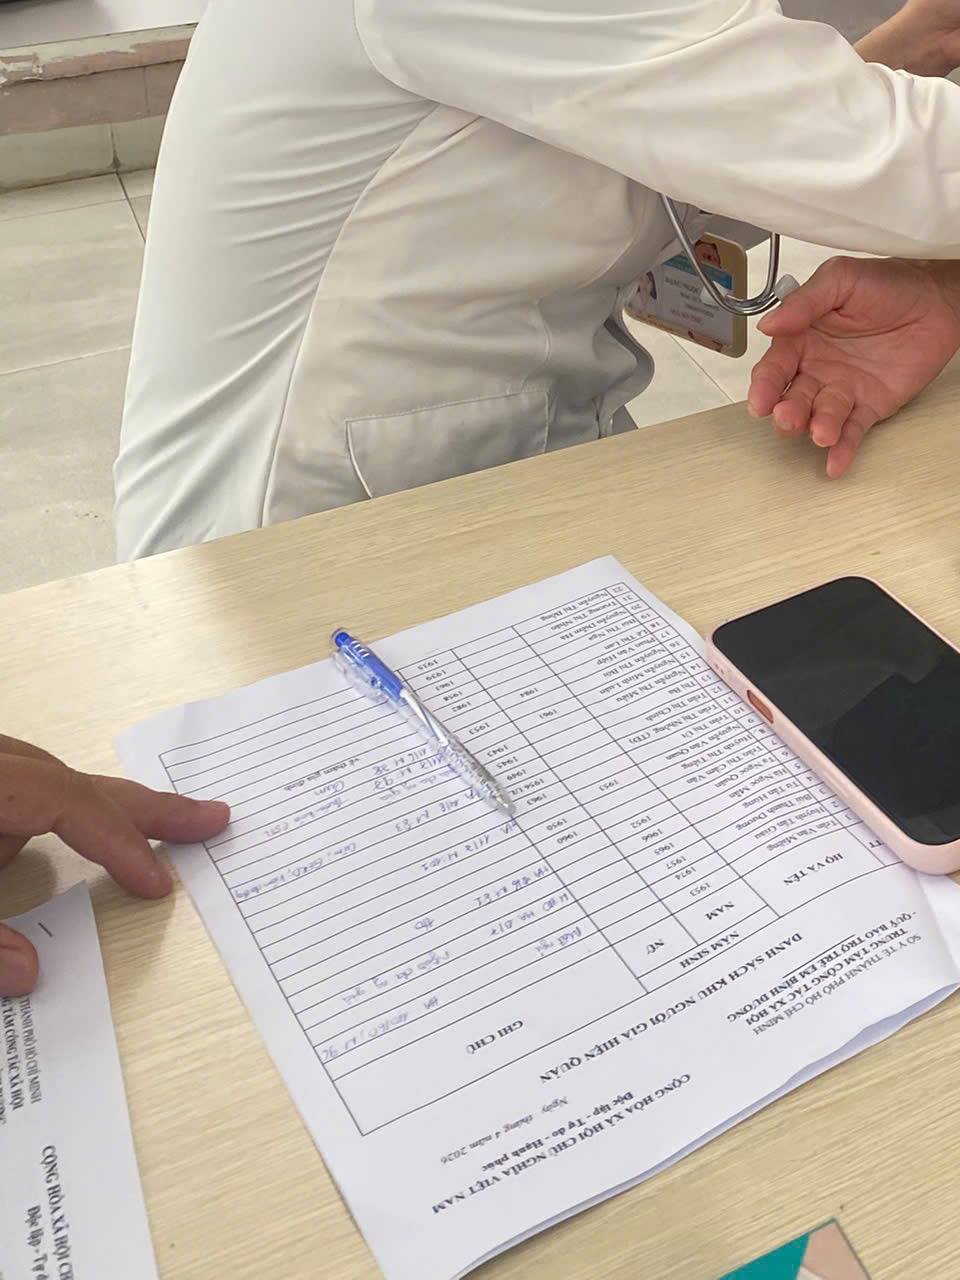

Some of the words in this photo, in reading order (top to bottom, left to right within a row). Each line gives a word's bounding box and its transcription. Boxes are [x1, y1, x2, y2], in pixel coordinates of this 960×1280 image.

[808, 862, 825, 874] VÀ
[822, 851, 843, 864] HỌ
[782, 870, 808, 886] TÊN
[704, 901, 735, 920] NAM
[642, 939, 665, 954] NỮ
[708, 931, 741, 952] NĂM
[763, 933, 803, 957] DANH
[839, 936, 864, 953] TRỢ
[869, 927, 907, 950] TRUNG
[896, 940, 907, 948] Y
[678, 948, 709, 967] SINH
[817, 951, 841, 967] TRẺ
[843, 947, 872, 965] TÂM
[843, 954, 885, 979] THÀNH
[727, 956, 767, 981] SÁCH
[797, 965, 817, 978] EM
[809, 962, 847, 986] CÔNG
[695, 978, 728, 999] KHU
[768, 976, 800, 997] BÌNH
[785, 983, 812, 1001] TÁC
[820, 976, 848, 996] PHỐ
[725, 994, 771, 1022] DƯƠNG
[768, 998, 787, 1012] XÃ
[803, 991, 824, 1006] HỒ
[648, 996, 697, 1027] NGƯỜI
[744, 1008, 768, 1025] HỘI
[782, 1002, 806, 1018] CHÍ
[496, 1019, 524, 1038] GHI
[620, 1022, 650, 1043] GIÀ
[752, 1014, 784, 1035] MINH
[3, 1028, 21, 1054] CÔNG
[463, 1033, 496, 1057] CHÚ
[581, 1034, 620, 1061] HIỆN
[653, 1072, 691, 1097] CỘNG
[7, 1088, 26, 1111] HỘI
[590, 1101, 610, 1117] lập
[611, 1091, 632, 1106] Độc
[624, 1094, 655, 1116] HÒA
[565, 1116, 584, 1131] Tự
[603, 1111, 624, 1127] XÃ
[551, 1126, 566, 1139] do
[576, 1121, 603, 1140] HỘI
[440, 1146, 467, 1165] 2026
[510, 1137, 542, 1159] Hạnh
[547, 1136, 577, 1158] CHỦ
[38, 1145, 60, 1183] CỘNG
[480, 1153, 510, 1175] phúc
[501, 1149, 545, 1179] NGHĨA
[467, 1172, 500, 1196] VIỆT
[46, 1183, 67, 1214] HÒA
[431, 1191, 465, 1214] NAM
[50, 1234, 71, 1261] HỘI
